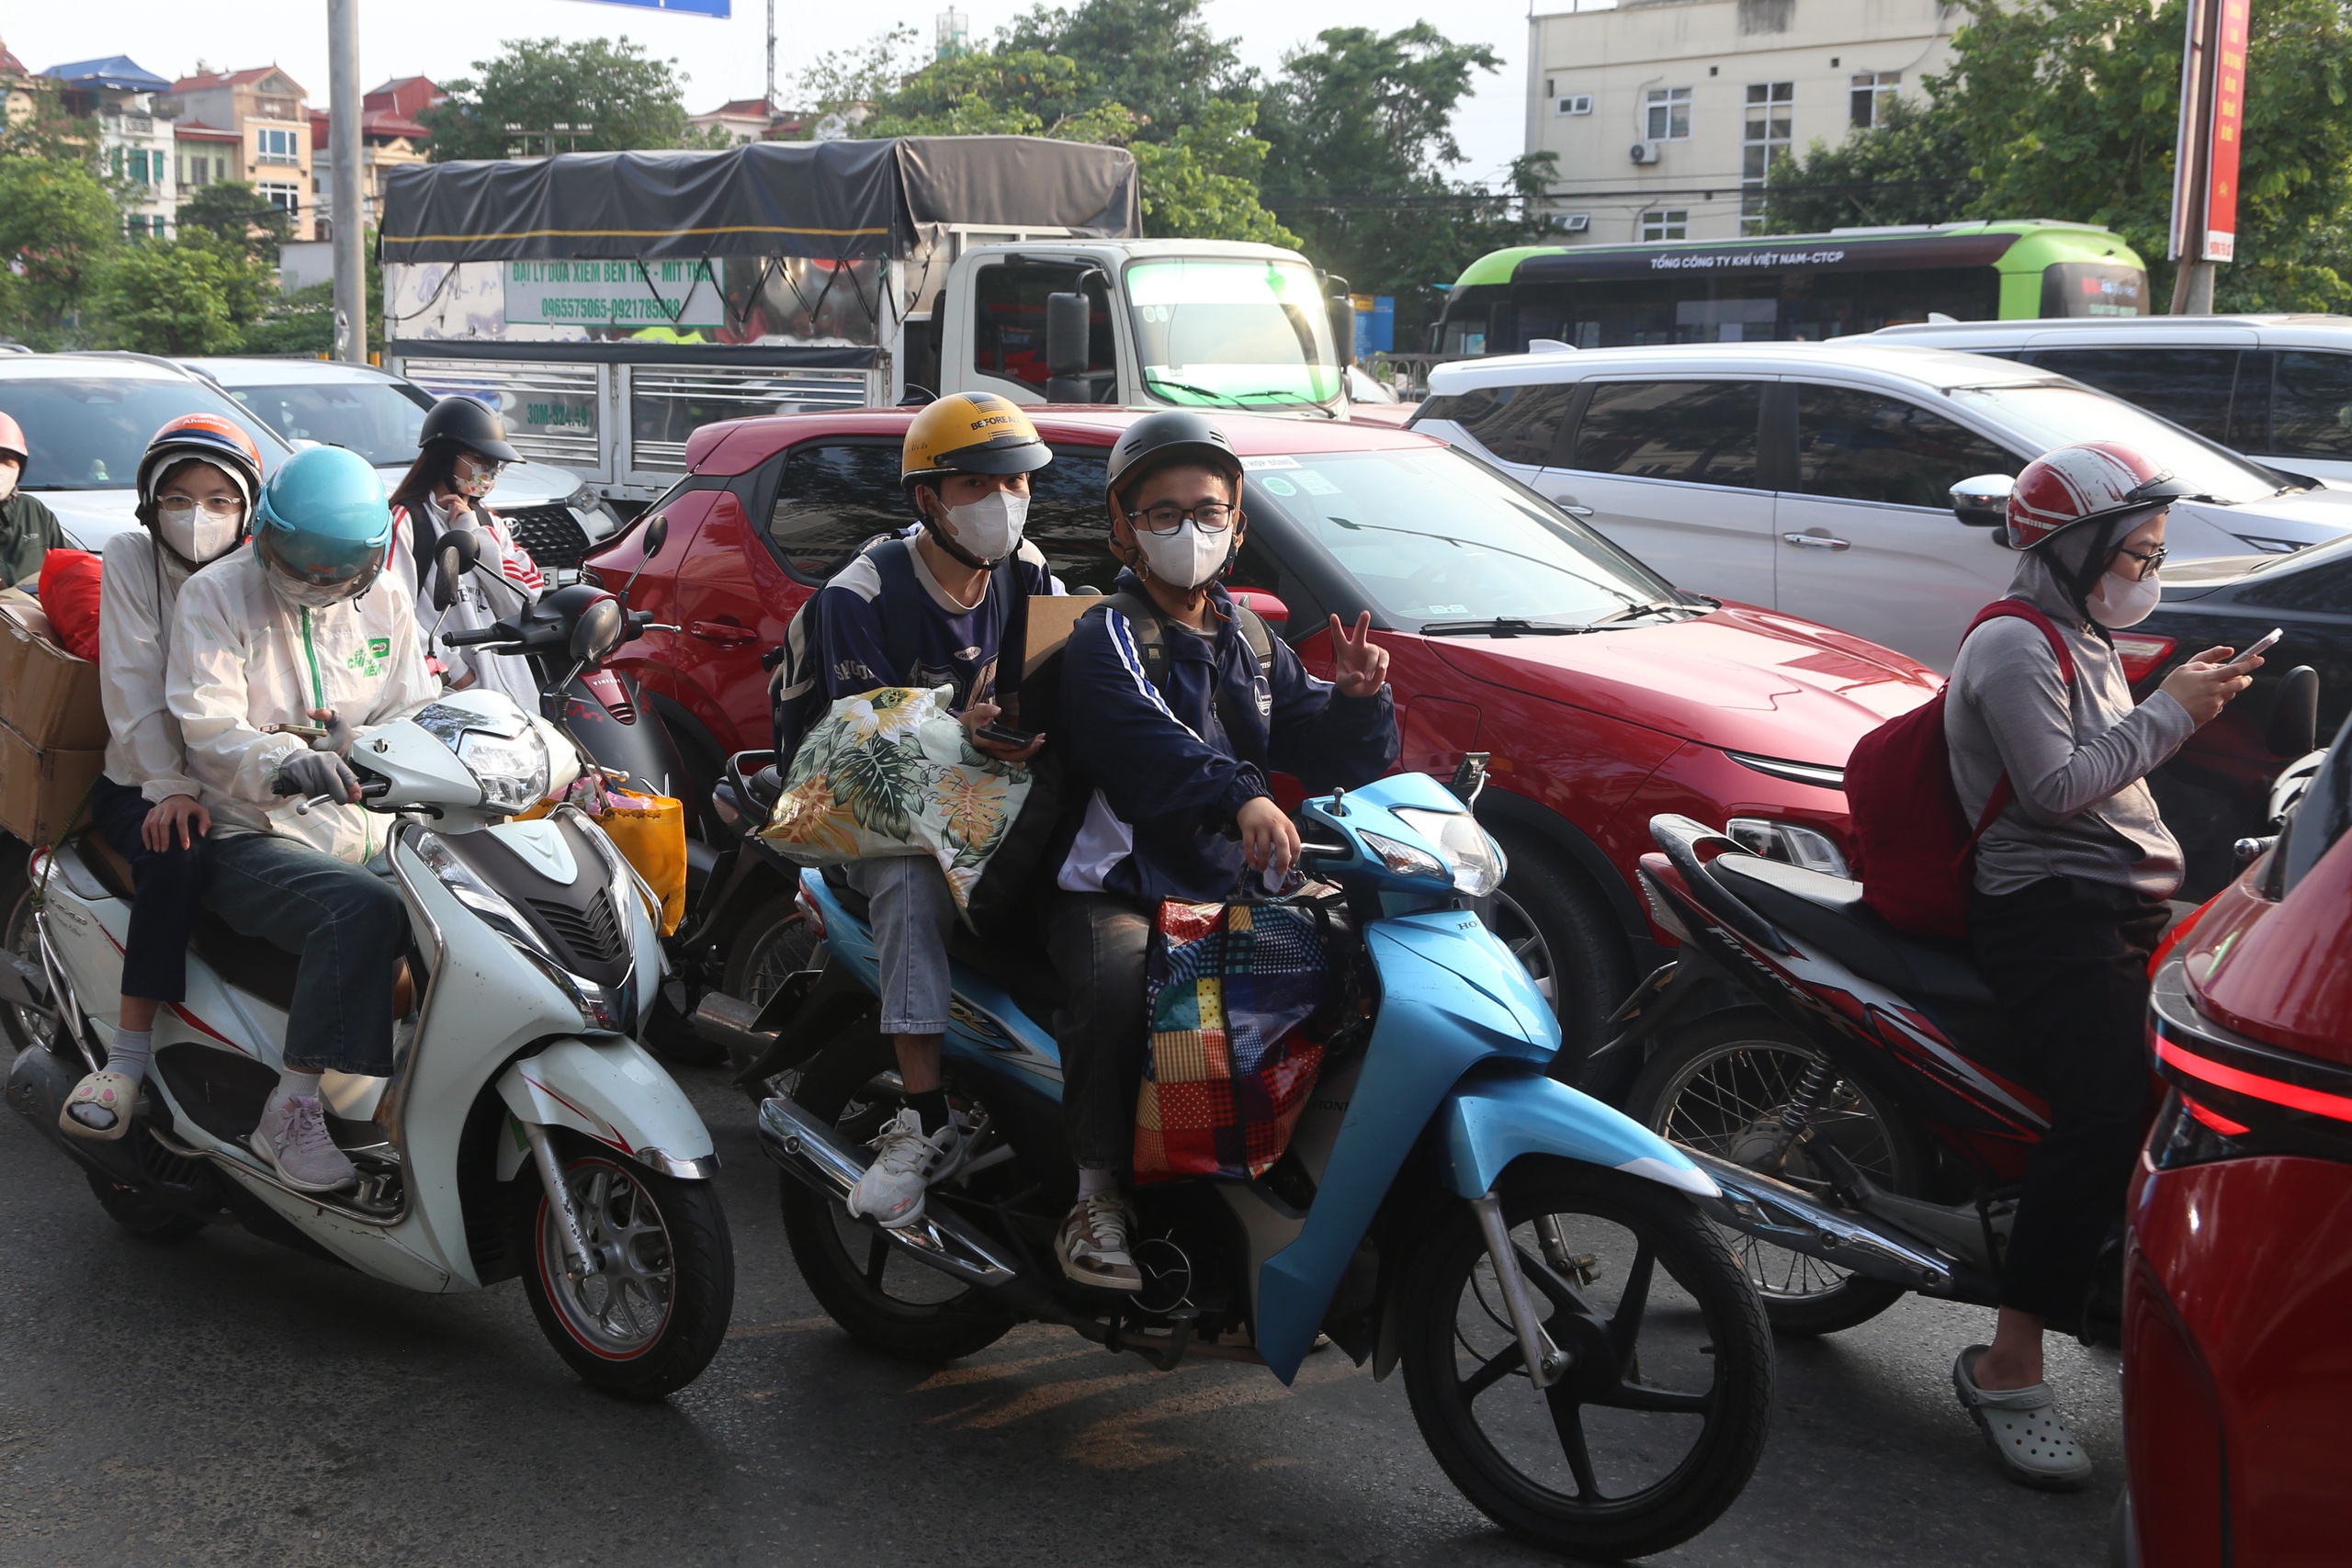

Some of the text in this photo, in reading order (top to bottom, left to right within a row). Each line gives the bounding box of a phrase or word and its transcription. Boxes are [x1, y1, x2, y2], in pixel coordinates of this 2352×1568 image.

[1651, 254, 1680, 269] TỔNG
[1681, 254, 1715, 268] CÔNG
[1716, 256, 1732, 267] TY
[1732, 253, 1753, 266] KHÍ
[1753, 252, 1780, 268] VIỆT
[183, 418, 230, 431] Ahamove
[970, 416, 1007, 431] BEFORE
[1705, 925, 1815, 1002] FUTURE
